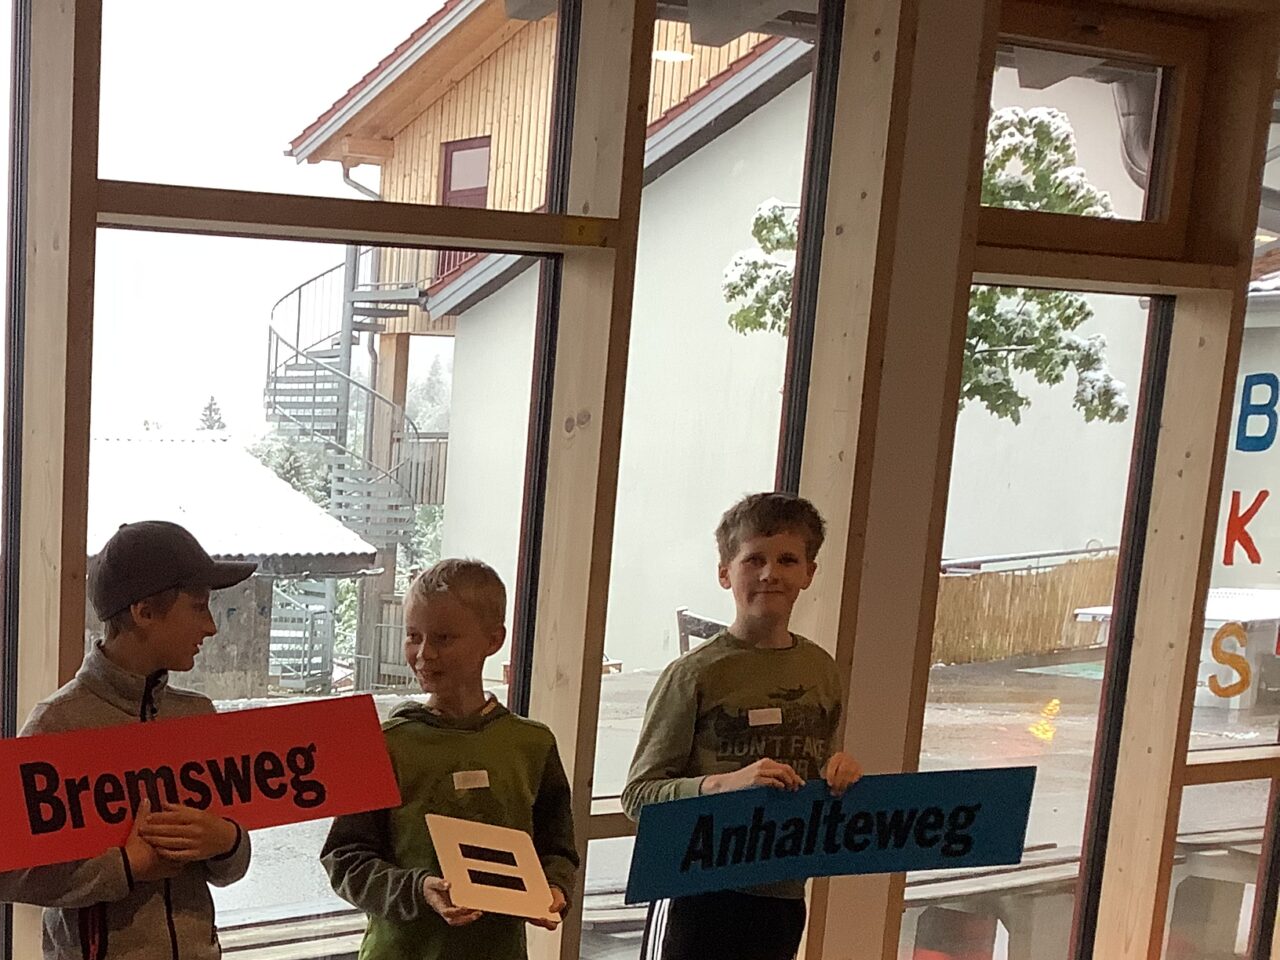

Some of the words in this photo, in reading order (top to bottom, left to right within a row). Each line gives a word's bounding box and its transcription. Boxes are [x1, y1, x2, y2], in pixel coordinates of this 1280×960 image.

[1235, 373, 1279, 452] B
[1223, 489, 1270, 566] K
[1208, 621, 1253, 698] S
[20, 743, 327, 835] Bremsweg
[680, 800, 983, 874] Anhalteweg
